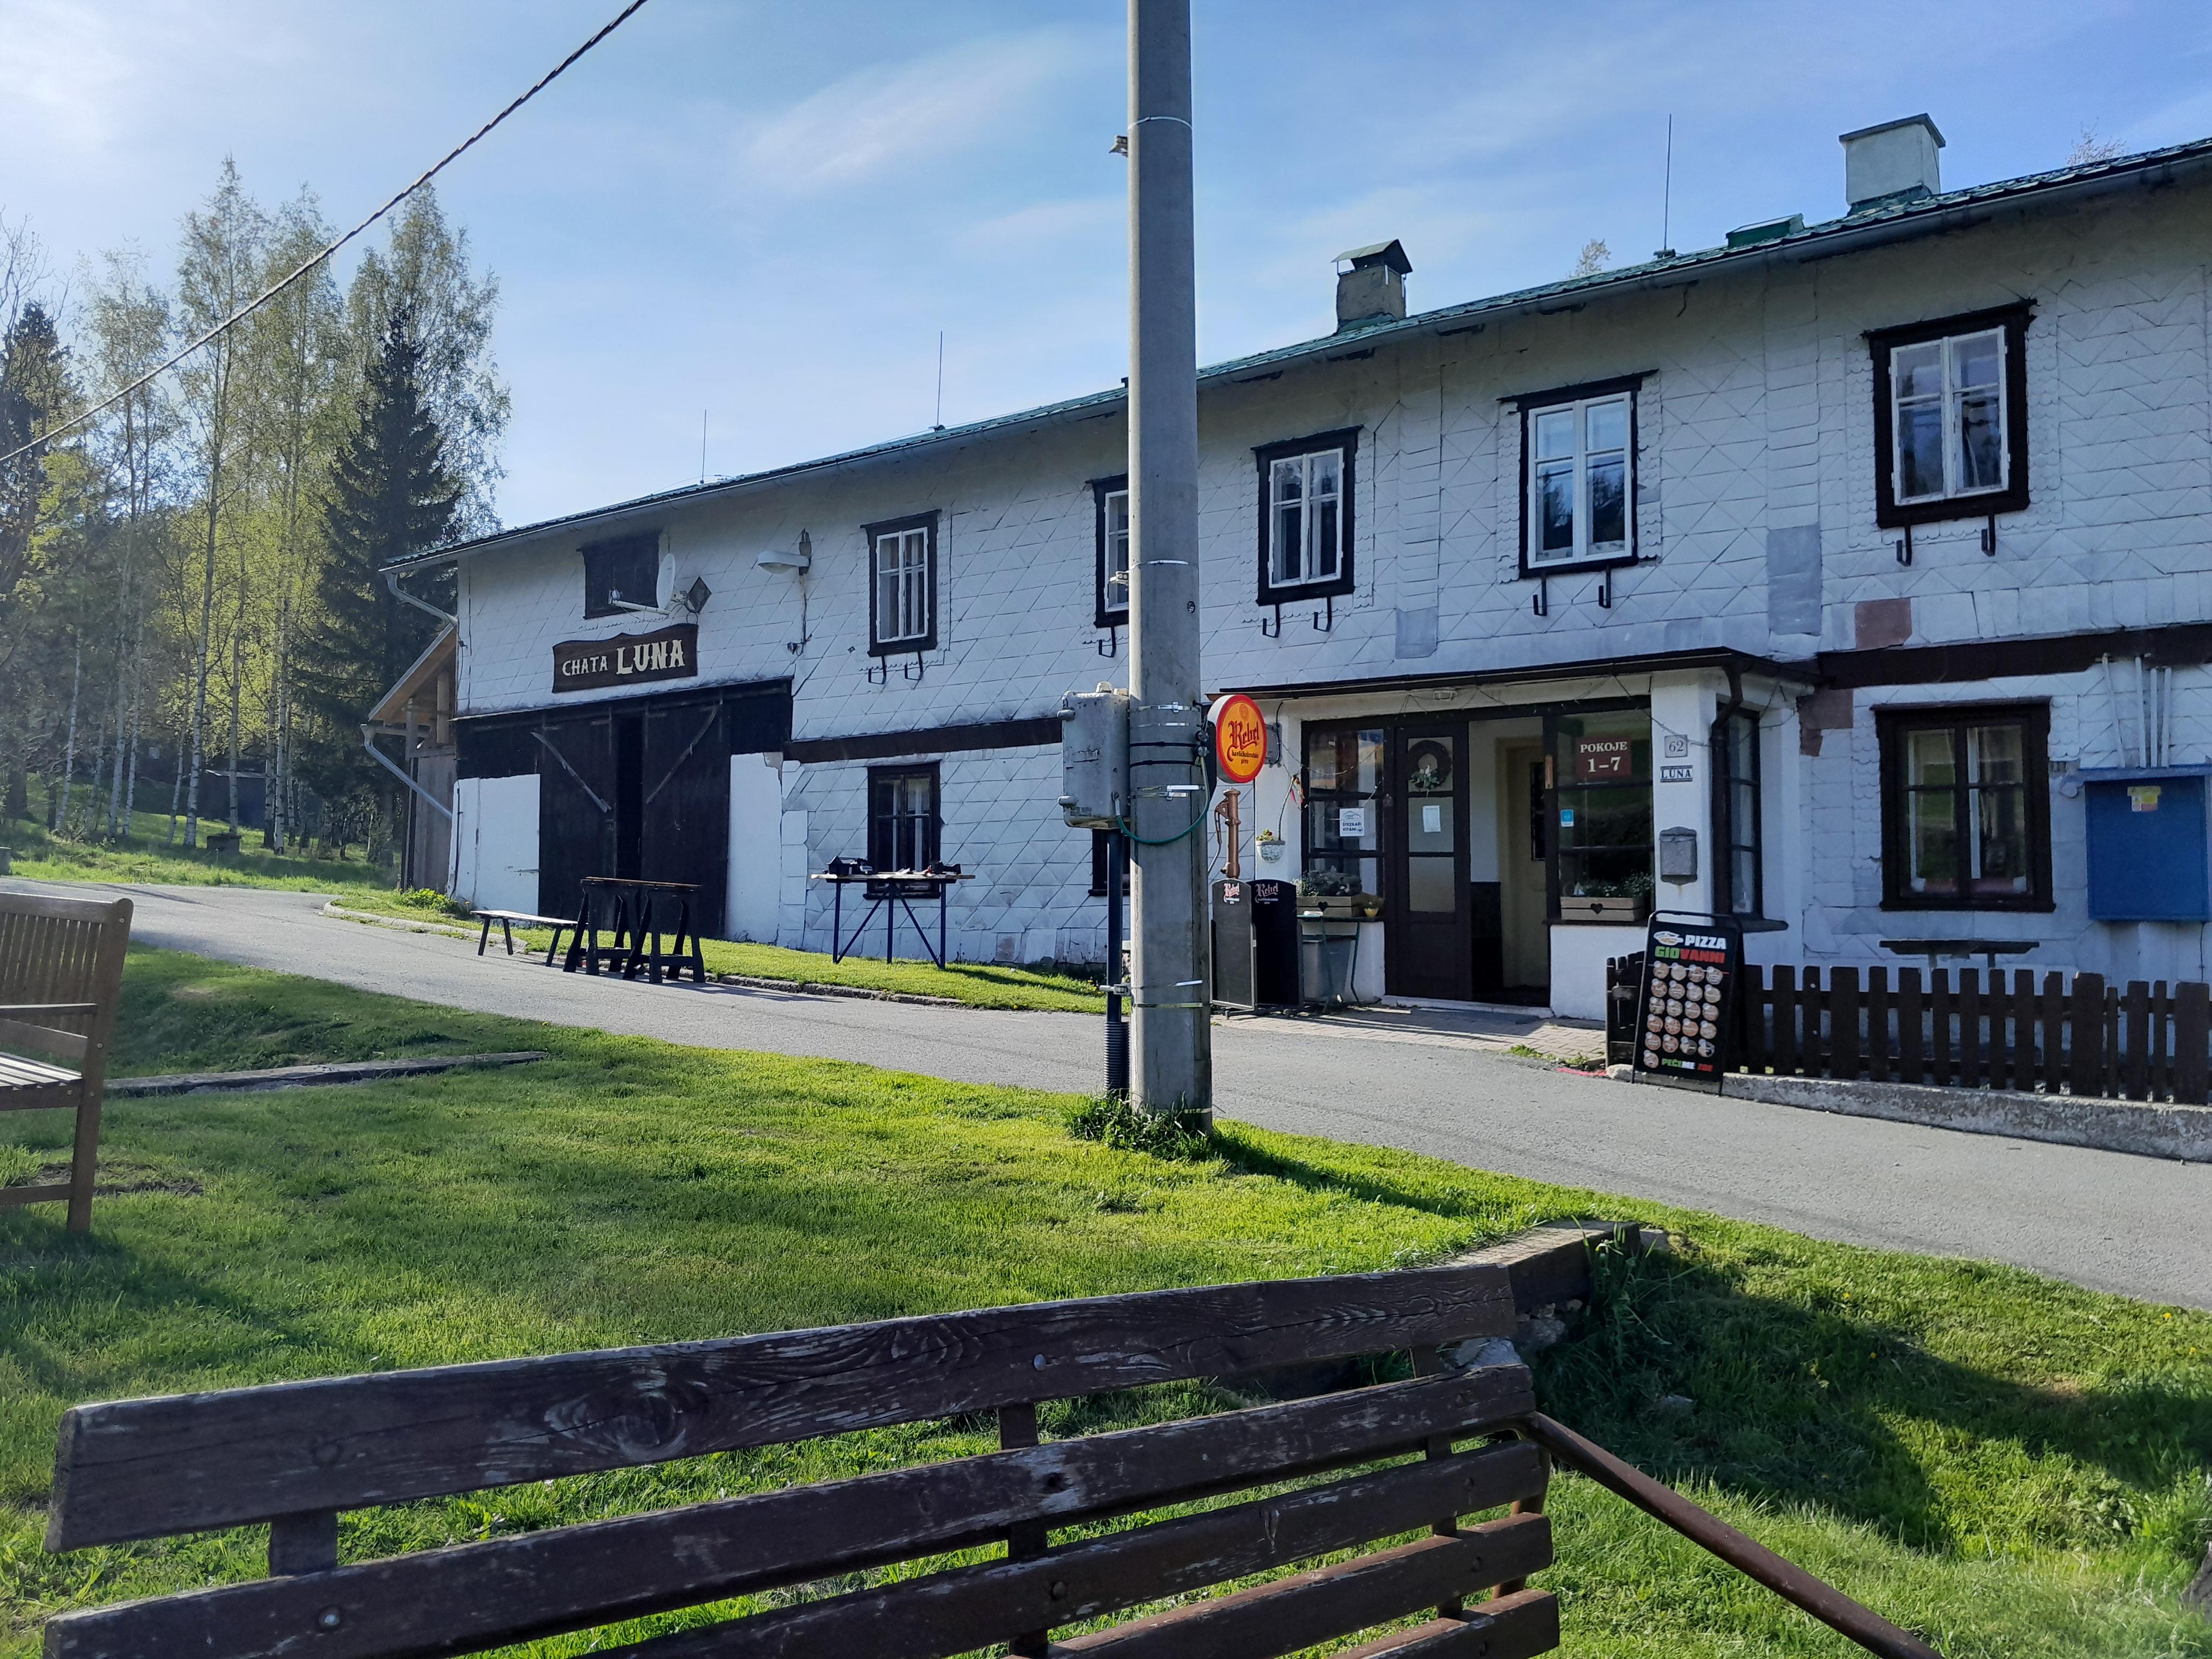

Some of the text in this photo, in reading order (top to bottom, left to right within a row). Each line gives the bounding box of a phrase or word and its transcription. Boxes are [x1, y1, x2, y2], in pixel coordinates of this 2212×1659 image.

[562, 639, 685, 676] CHATA LUNA
[1228, 720, 1259, 750] Rebel
[1580, 741, 1628, 753] POKOJE
[1669, 740, 1684, 752] 62
[1684, 935, 1727, 949] PIZZA
[1655, 946, 1725, 963] GIOVANNI
